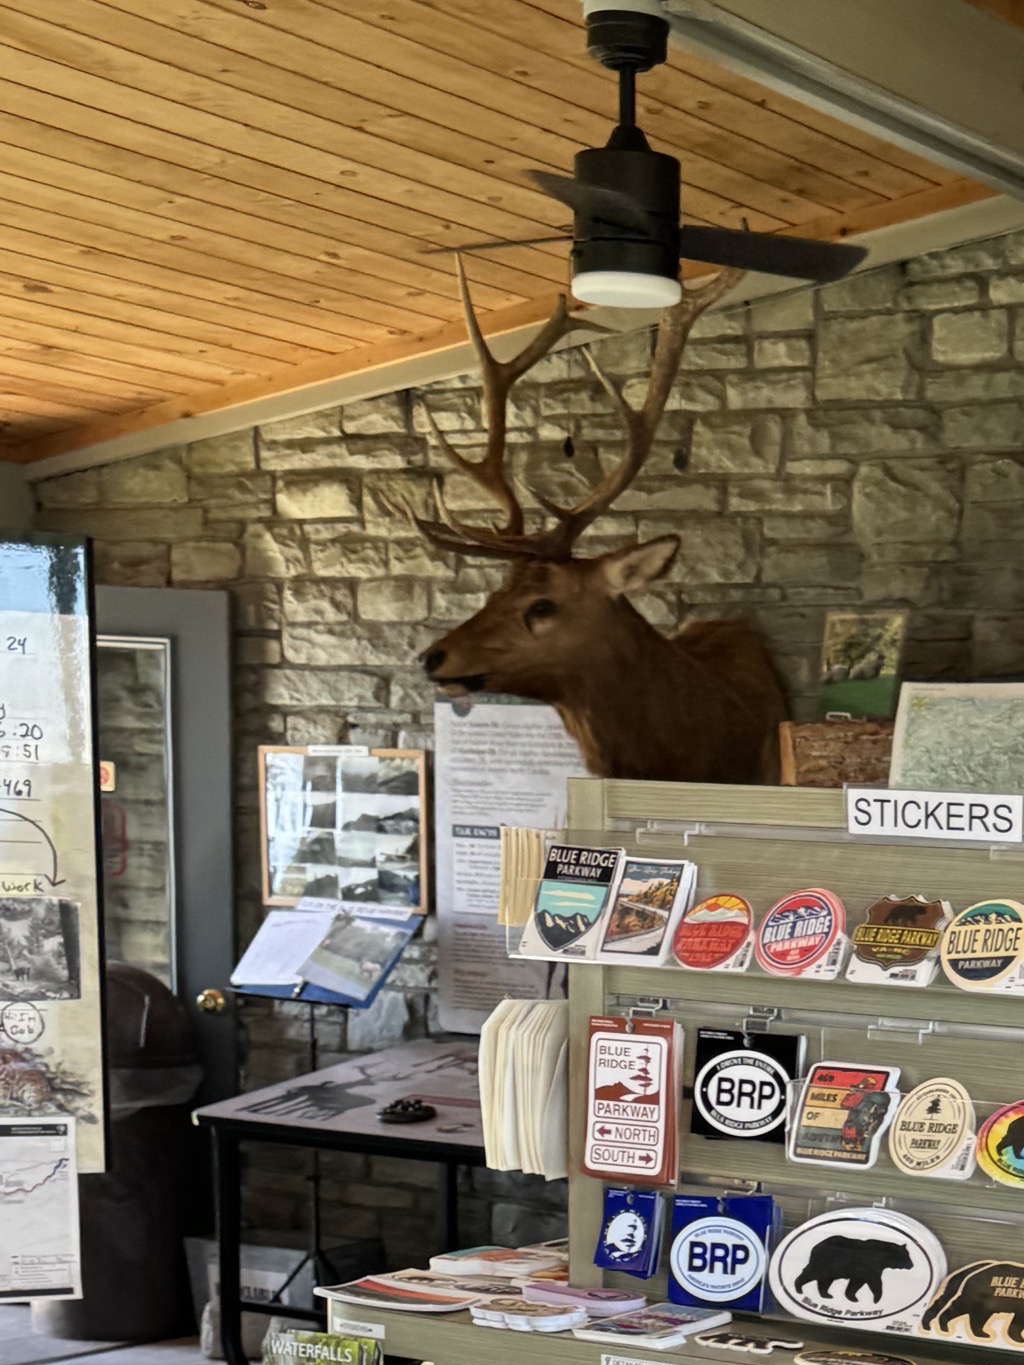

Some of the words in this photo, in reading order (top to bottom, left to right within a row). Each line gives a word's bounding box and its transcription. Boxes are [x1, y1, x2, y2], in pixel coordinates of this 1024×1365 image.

[6, 636, 27, 652] 24
[854, 798, 1013, 834] STICKERS
[549, 848, 577, 863] BLUE
[579, 851, 617, 868] RIDGE
[556, 864, 602, 878] PARKWAY
[763, 924, 791, 944] BLUE
[794, 916, 832, 935] RIDGE
[770, 935, 821, 952] PARKWAY
[946, 927, 982, 956] BLUE
[983, 925, 1022, 953] RIDGE
[957, 957, 1004, 971] PARKWAY
[599, 1045, 632, 1057] BLUE
[598, 1058, 636, 1070] RIDGE
[817, 1074, 835, 1082] 469
[716, 1076, 775, 1110] BRP
[810, 1092, 838, 1102] MILES
[596, 1102, 656, 1120] PARKWAY
[806, 1112, 820, 1120] OF
[614, 1127, 656, 1143] NORTH
[899, 1121, 926, 1133] BLUE
[927, 1123, 959, 1134] RIDGE
[909, 1138, 941, 1149] PARKWAY
[592, 1148, 636, 1164] SOUTH
[688, 1241, 750, 1275] BRP
[989, 1275, 1020, 1290] BLUE
[801, 1296, 819, 1311] Blue
[819, 1302, 843, 1318] Ridge
[843, 1306, 885, 1318] Parkway
[271, 1339, 353, 1363] WATERFALLS
